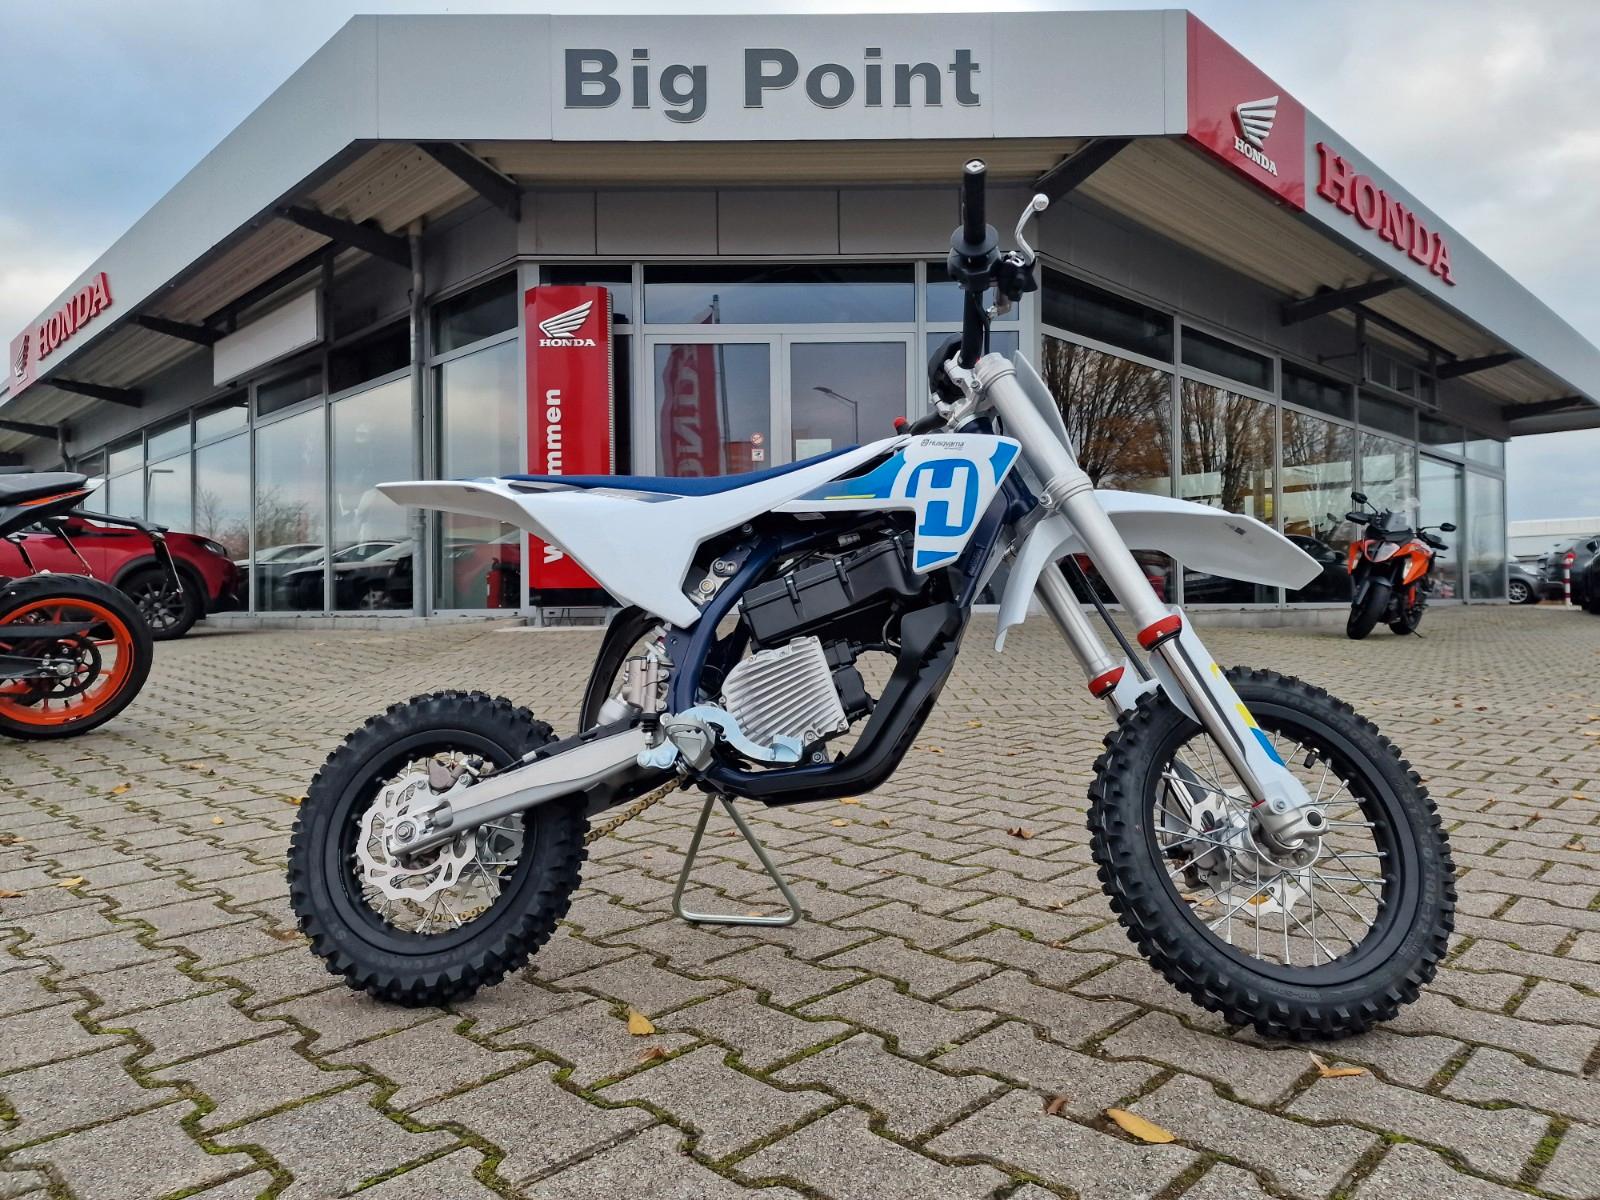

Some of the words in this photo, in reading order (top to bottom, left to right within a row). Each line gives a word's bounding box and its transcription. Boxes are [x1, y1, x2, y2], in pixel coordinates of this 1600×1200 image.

[564, 47, 708, 123] Big
[743, 48, 981, 108] Point
[1234, 136, 1278, 177] HONDA
[1316, 141, 1457, 287] HONDA
[38, 271, 113, 361] HONDA
[539, 338, 596, 347] HONDA
